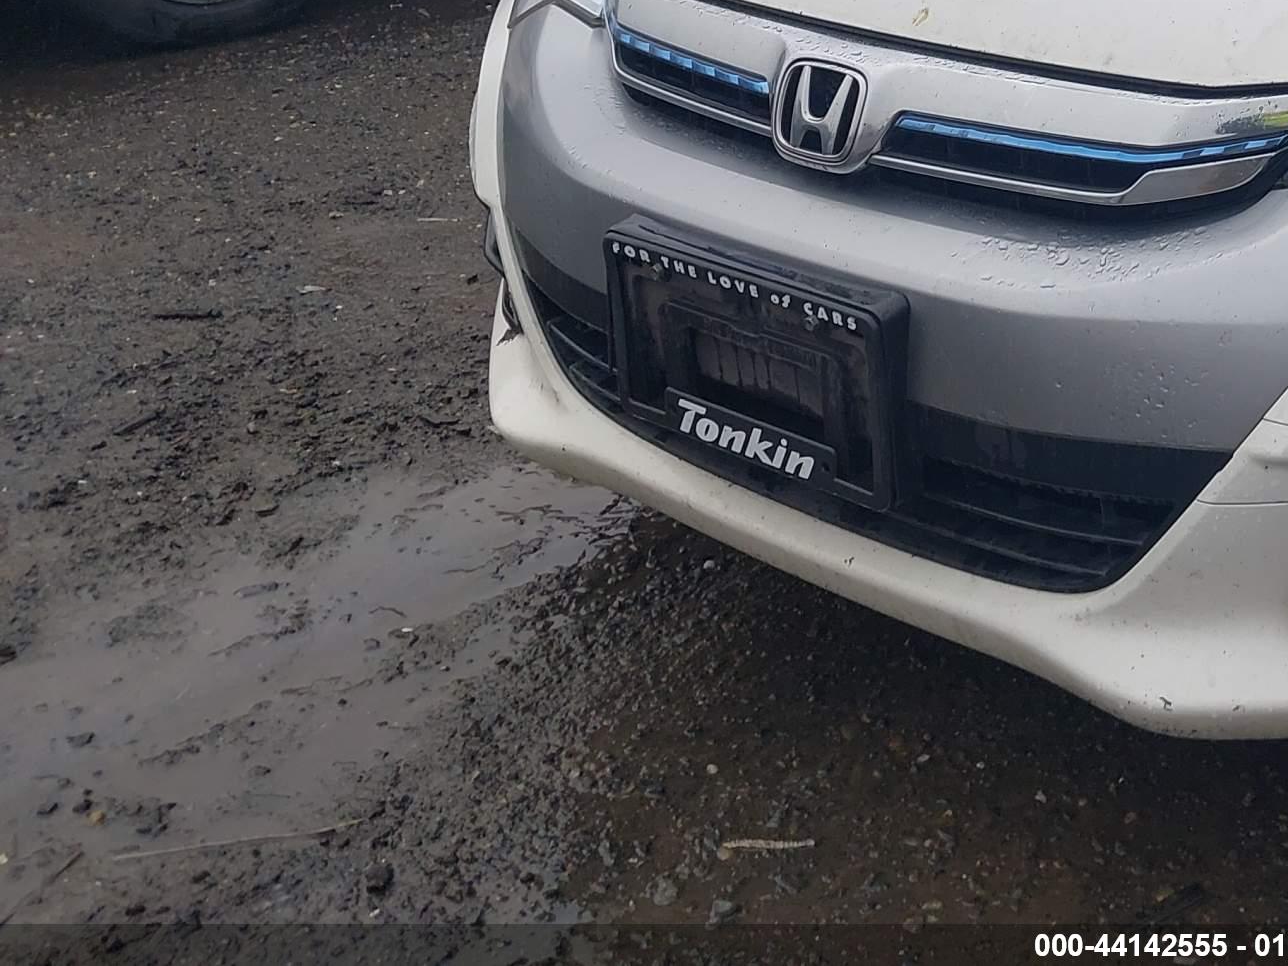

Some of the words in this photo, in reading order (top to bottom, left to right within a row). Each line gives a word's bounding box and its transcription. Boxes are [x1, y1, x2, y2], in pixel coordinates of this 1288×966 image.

[612, 241, 651, 263] FOR
[660, 256, 697, 278] THE
[707, 271, 759, 298] LOVE
[770, 292, 791, 308] of
[803, 301, 857, 331] CARS
[677, 398, 815, 480] Tonkin
